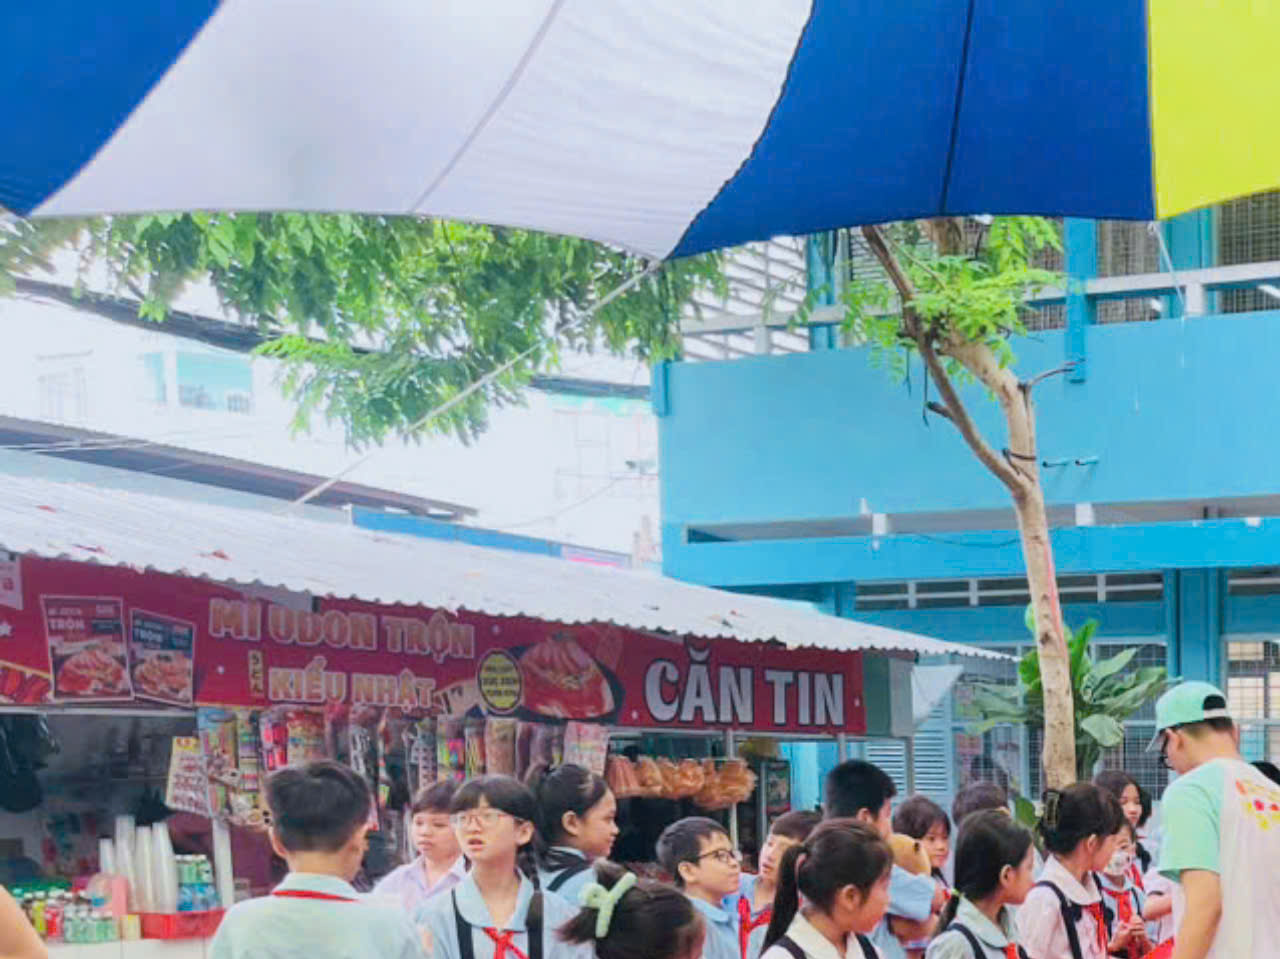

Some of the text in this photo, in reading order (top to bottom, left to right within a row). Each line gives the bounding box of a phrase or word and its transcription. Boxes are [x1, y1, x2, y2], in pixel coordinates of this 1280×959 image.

[268, 603, 378, 651] UDON
[381, 606, 475, 664] TRỘN
[268, 655, 347, 703] KIỂU
[352, 667, 436, 712] NHẬT
[645, 647, 844, 726] CĂN TIN
